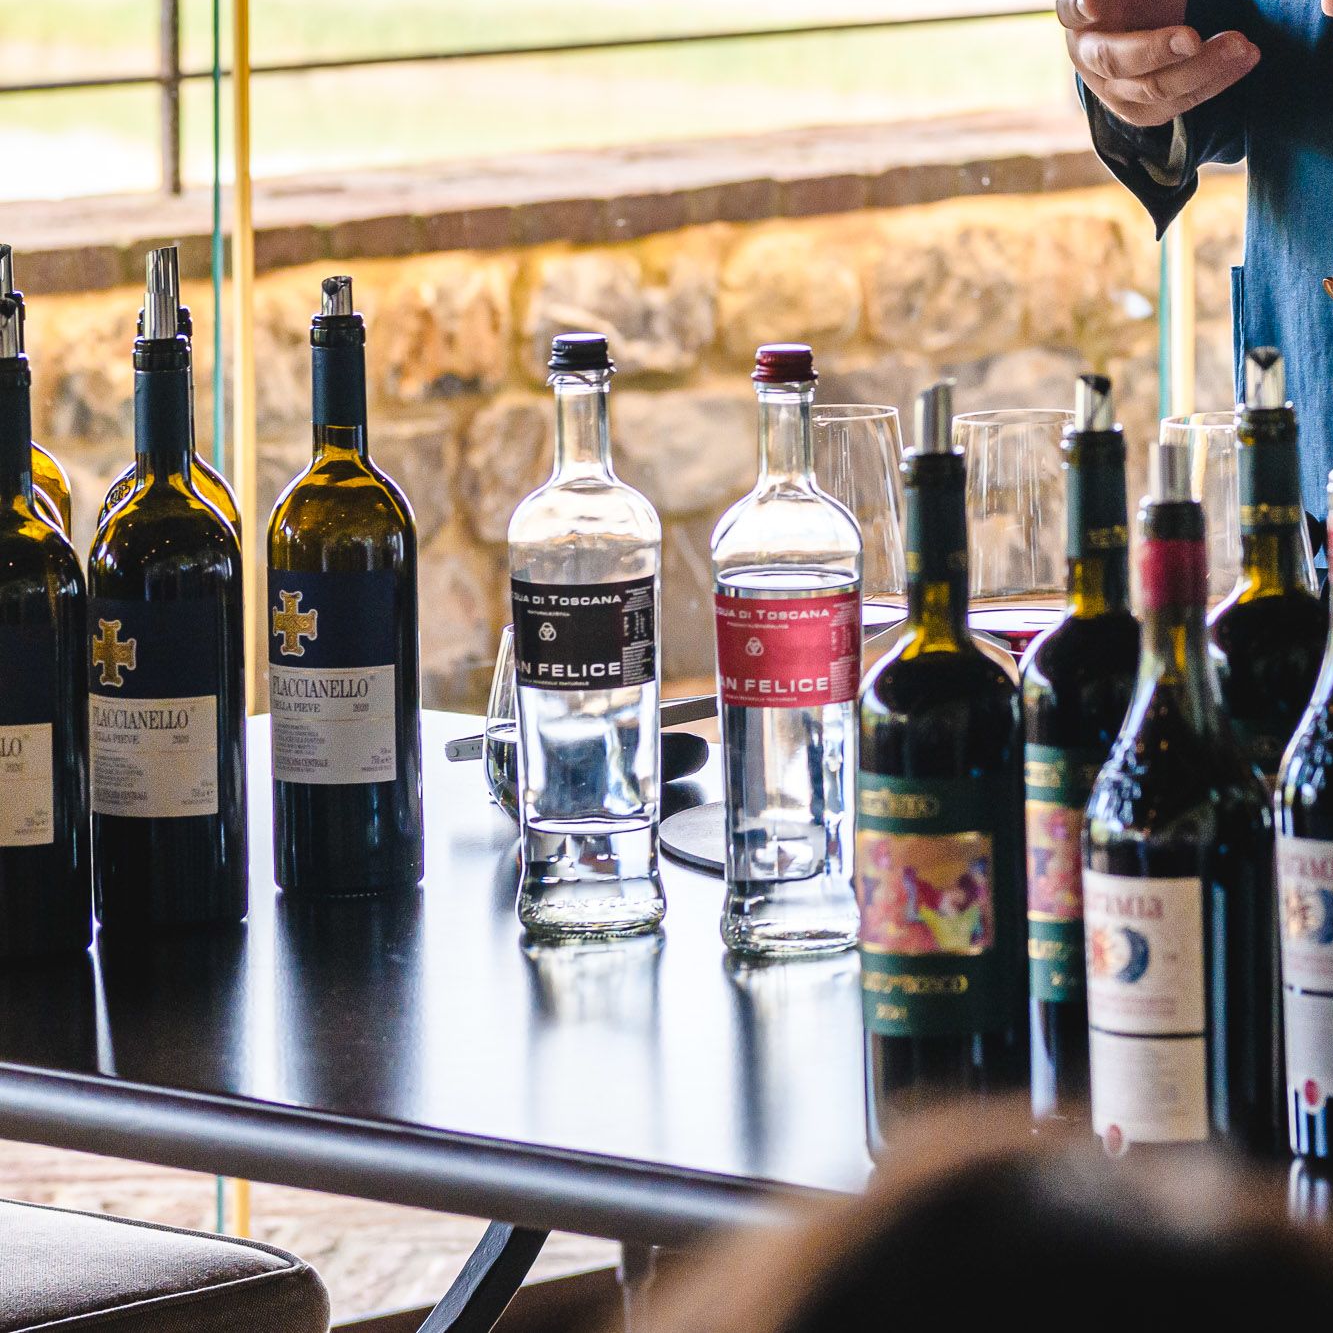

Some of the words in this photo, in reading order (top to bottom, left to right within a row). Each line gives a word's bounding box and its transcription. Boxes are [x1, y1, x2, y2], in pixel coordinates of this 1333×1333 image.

[532, 596, 544, 604] DI
[548, 595, 622, 606] TOSCANA
[738, 610, 751, 619] DI
[756, 609, 830, 621] TOSCANA
[538, 661, 621, 678] FELICE
[745, 677, 829, 693] FELICE
[294, 702, 321, 713] PIEVE
